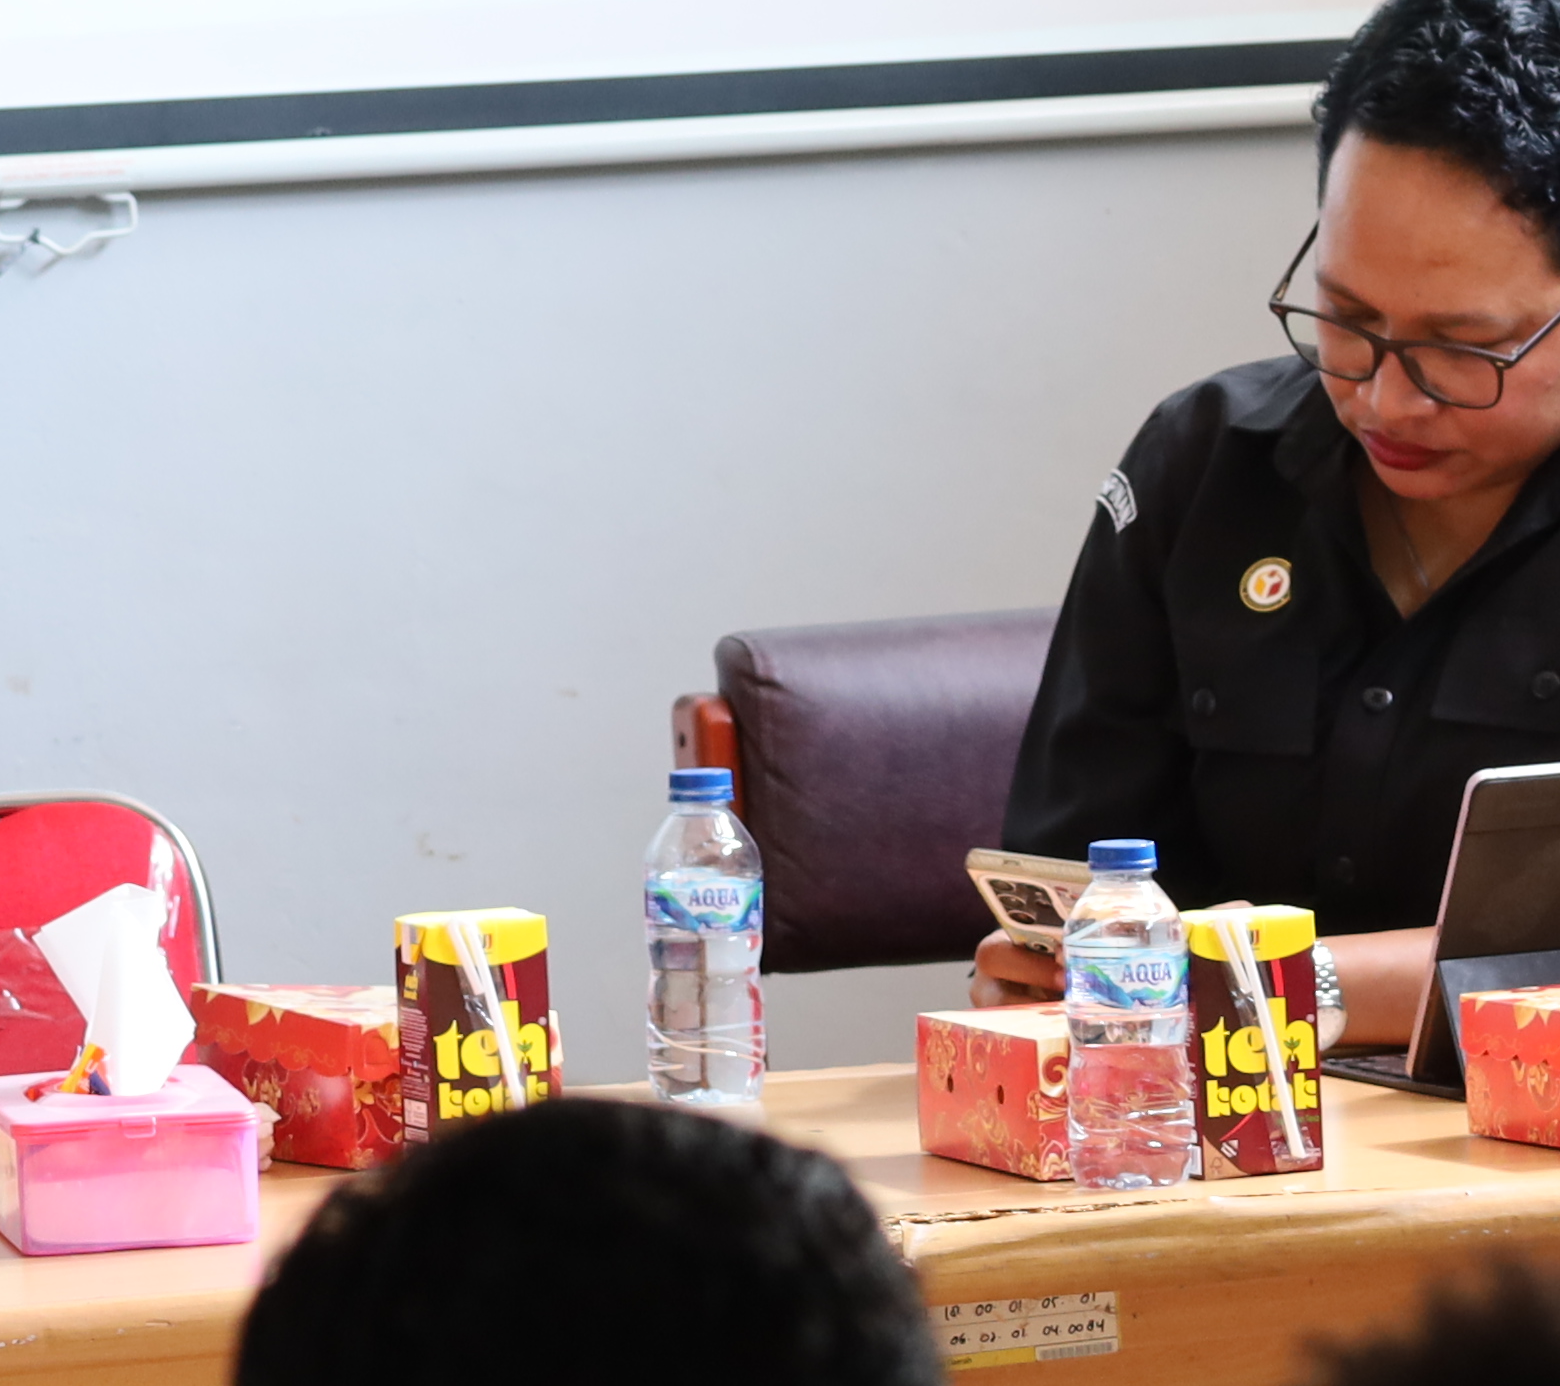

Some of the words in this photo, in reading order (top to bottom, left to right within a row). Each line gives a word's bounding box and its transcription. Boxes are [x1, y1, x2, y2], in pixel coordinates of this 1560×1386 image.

[688, 888, 740, 910] AQUA
[1120, 962, 1172, 986] AQUA
[433, 999, 548, 1080] teh
[1201, 997, 1317, 1077] teh
[1206, 1072, 1318, 1117] kotak
